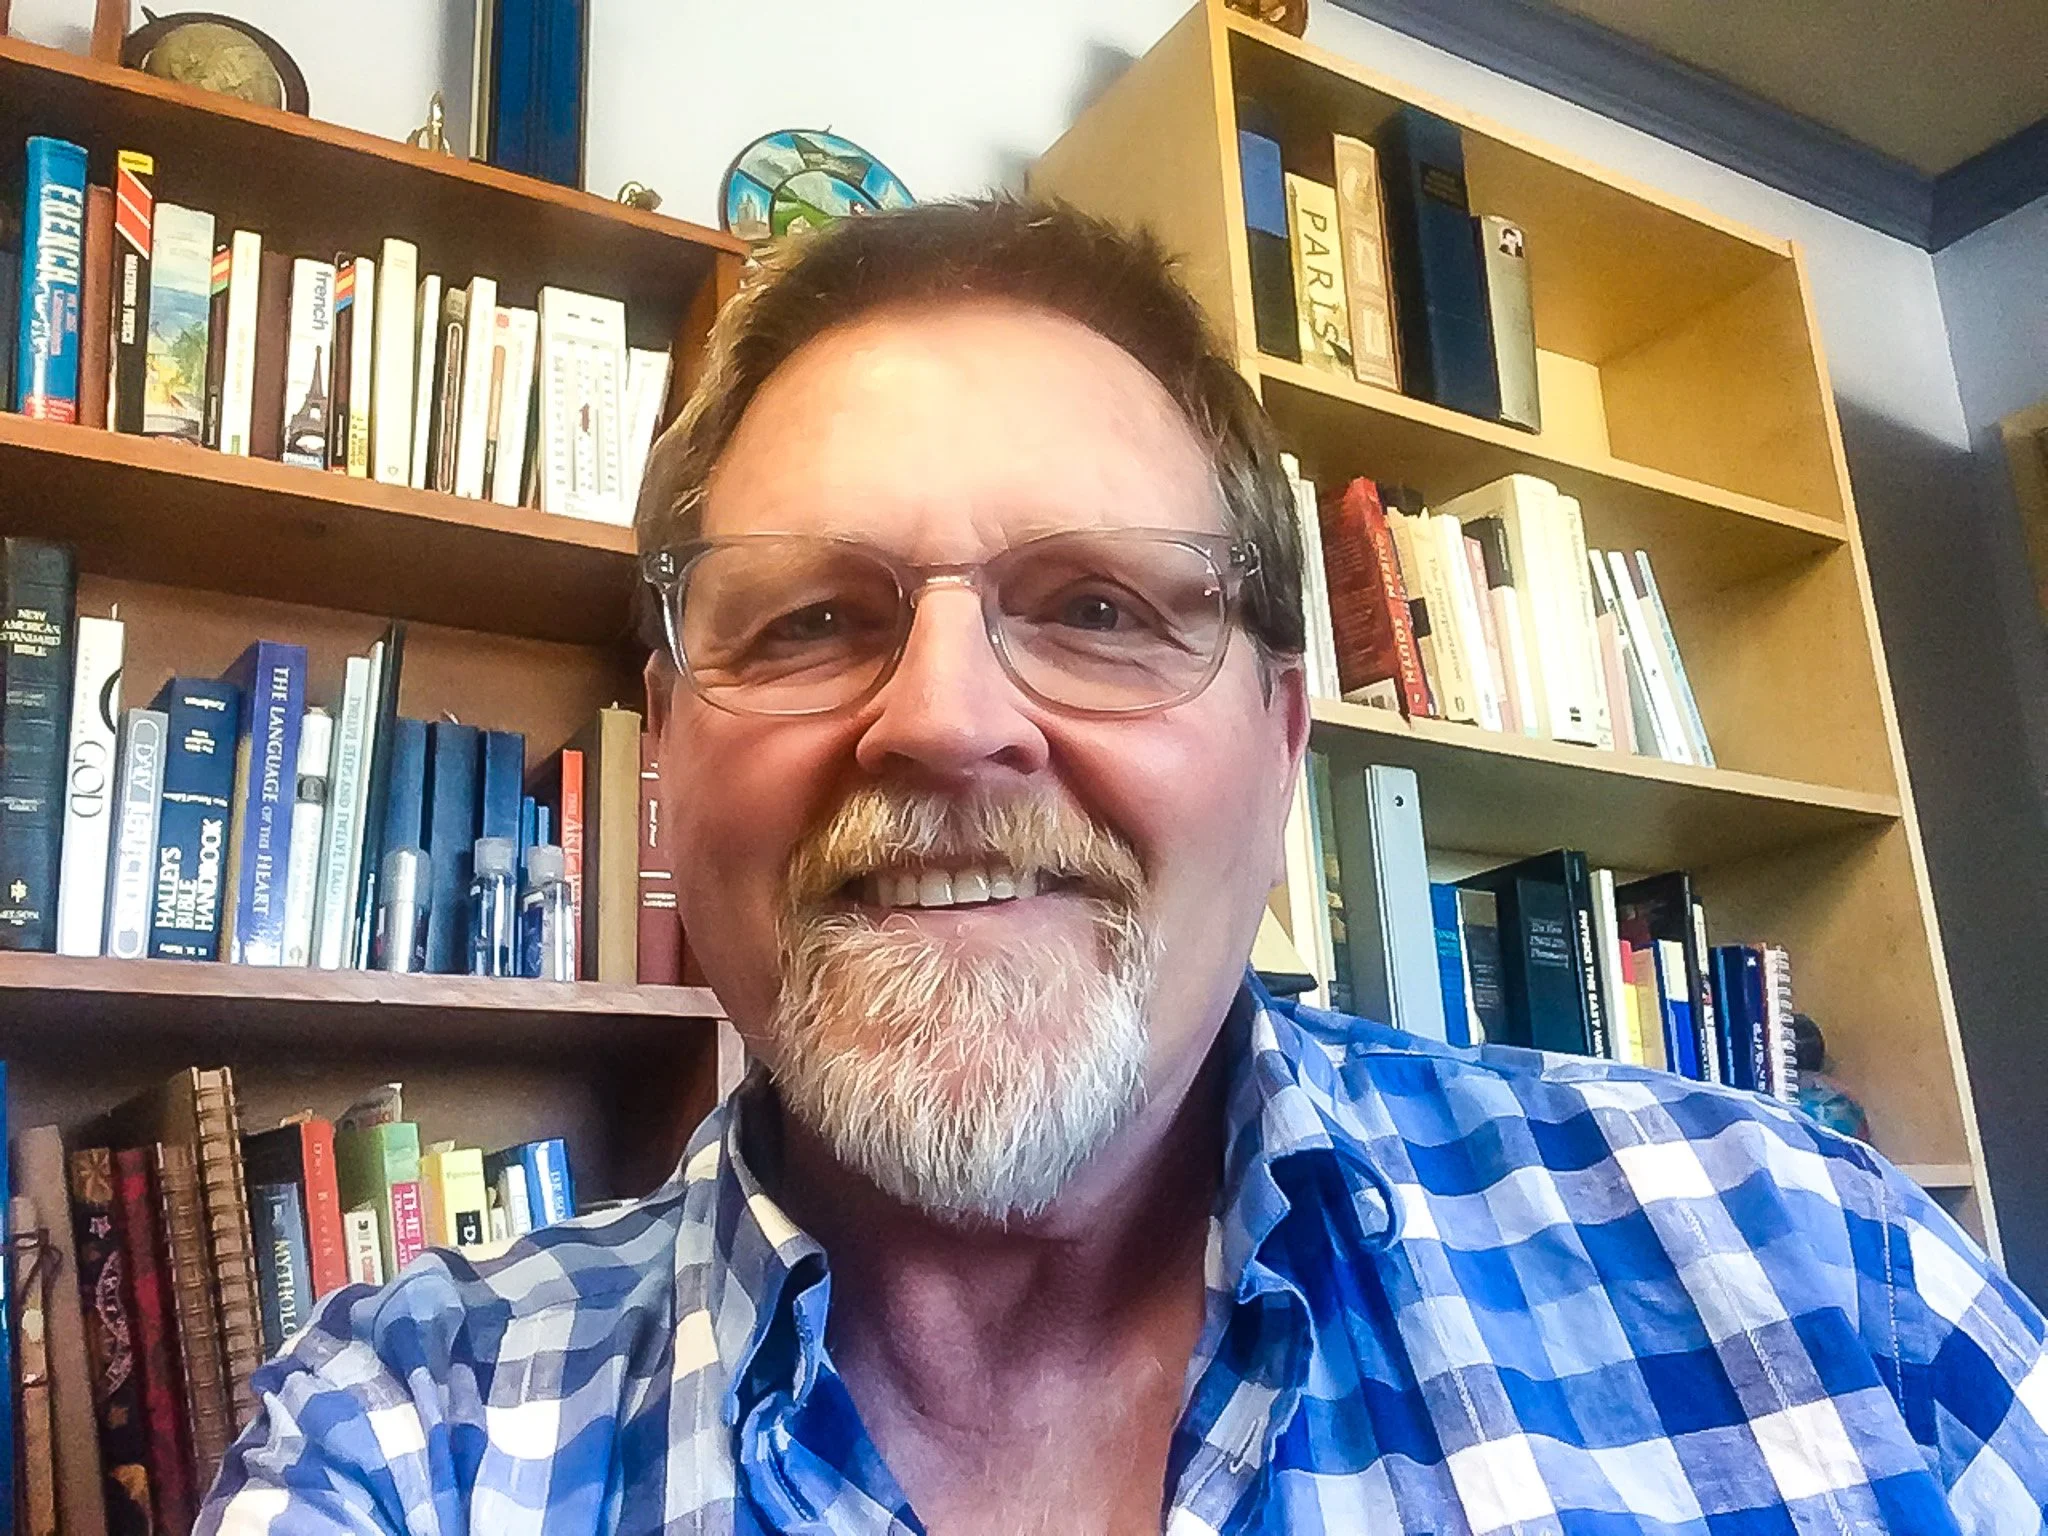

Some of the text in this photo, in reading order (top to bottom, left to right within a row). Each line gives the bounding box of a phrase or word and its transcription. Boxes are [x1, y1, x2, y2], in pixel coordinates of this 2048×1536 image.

[37, 184, 83, 285] FRENCH
[312, 271, 330, 331] french
[1301, 208, 1341, 341] PARIS
[272, 667, 290, 702] THE
[72, 740, 107, 818] GOD
[262, 705, 287, 805] LANGUAGE
[175, 879, 198, 929] BIBLE
[195, 818, 223, 932] HANDBOOK
[253, 854, 273, 916] HEART
